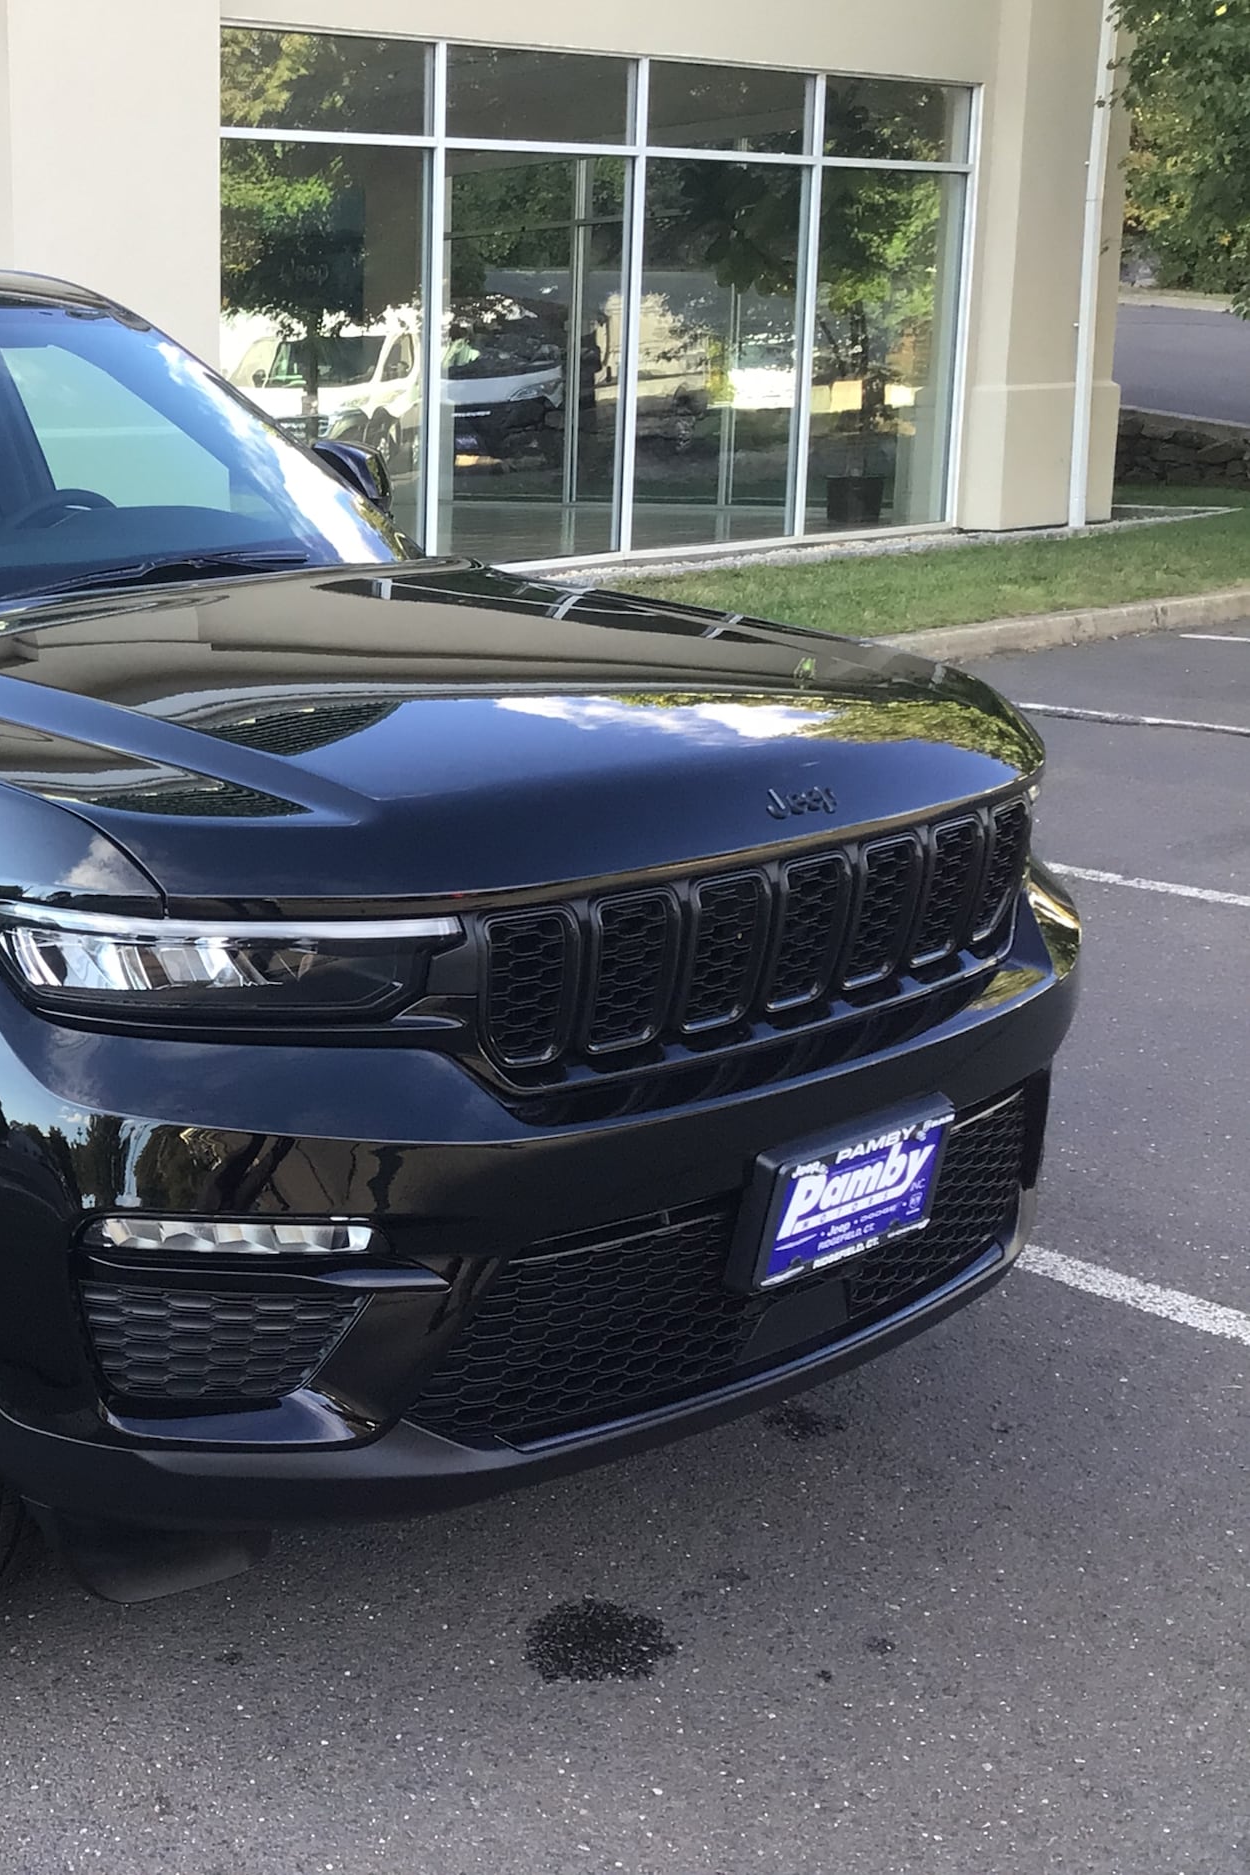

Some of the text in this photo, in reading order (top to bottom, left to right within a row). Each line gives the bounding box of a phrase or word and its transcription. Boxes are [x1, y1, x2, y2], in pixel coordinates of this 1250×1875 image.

[767, 787, 837, 819] Jeep
[835, 1124, 916, 1164] PAMBY
[776, 1142, 936, 1241] Pamby
[827, 1221, 851, 1237] Jeep
